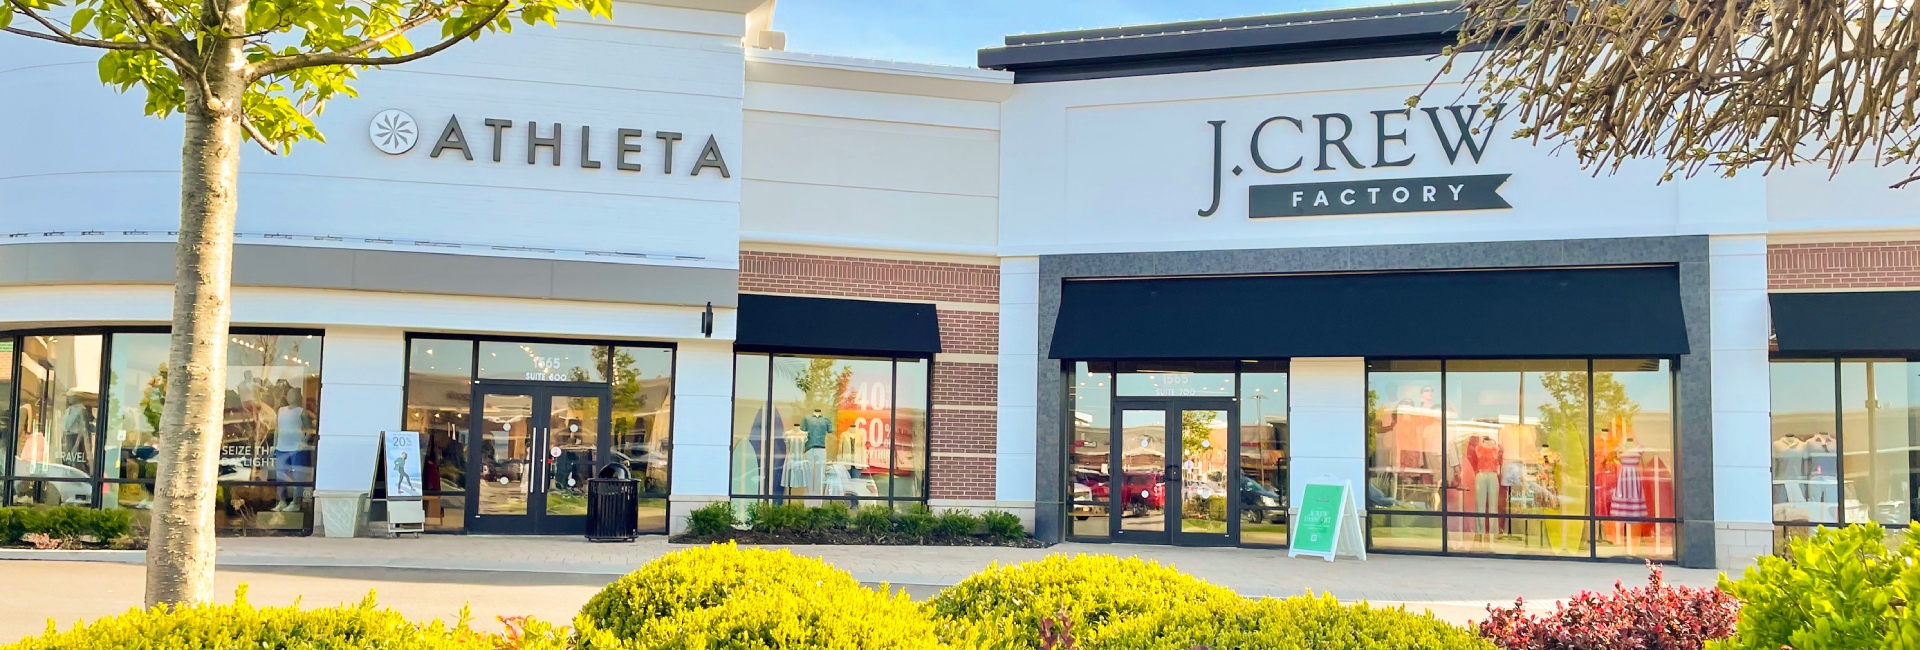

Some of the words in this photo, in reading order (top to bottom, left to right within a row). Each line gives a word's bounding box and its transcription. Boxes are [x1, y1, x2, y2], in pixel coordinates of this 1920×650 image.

[430, 113, 731, 178] ATHLETA
[1198, 103, 1508, 217] J.CREW
[1292, 184, 1466, 208] FACTORY
[533, 357, 561, 369] 1565
[525, 371, 546, 381] SUITE
[1155, 388, 1175, 397] SUITE
[1179, 388, 1196, 397] 700
[221, 445, 252, 456] SEIZE
[221, 457, 277, 467] DAYLIGHT
